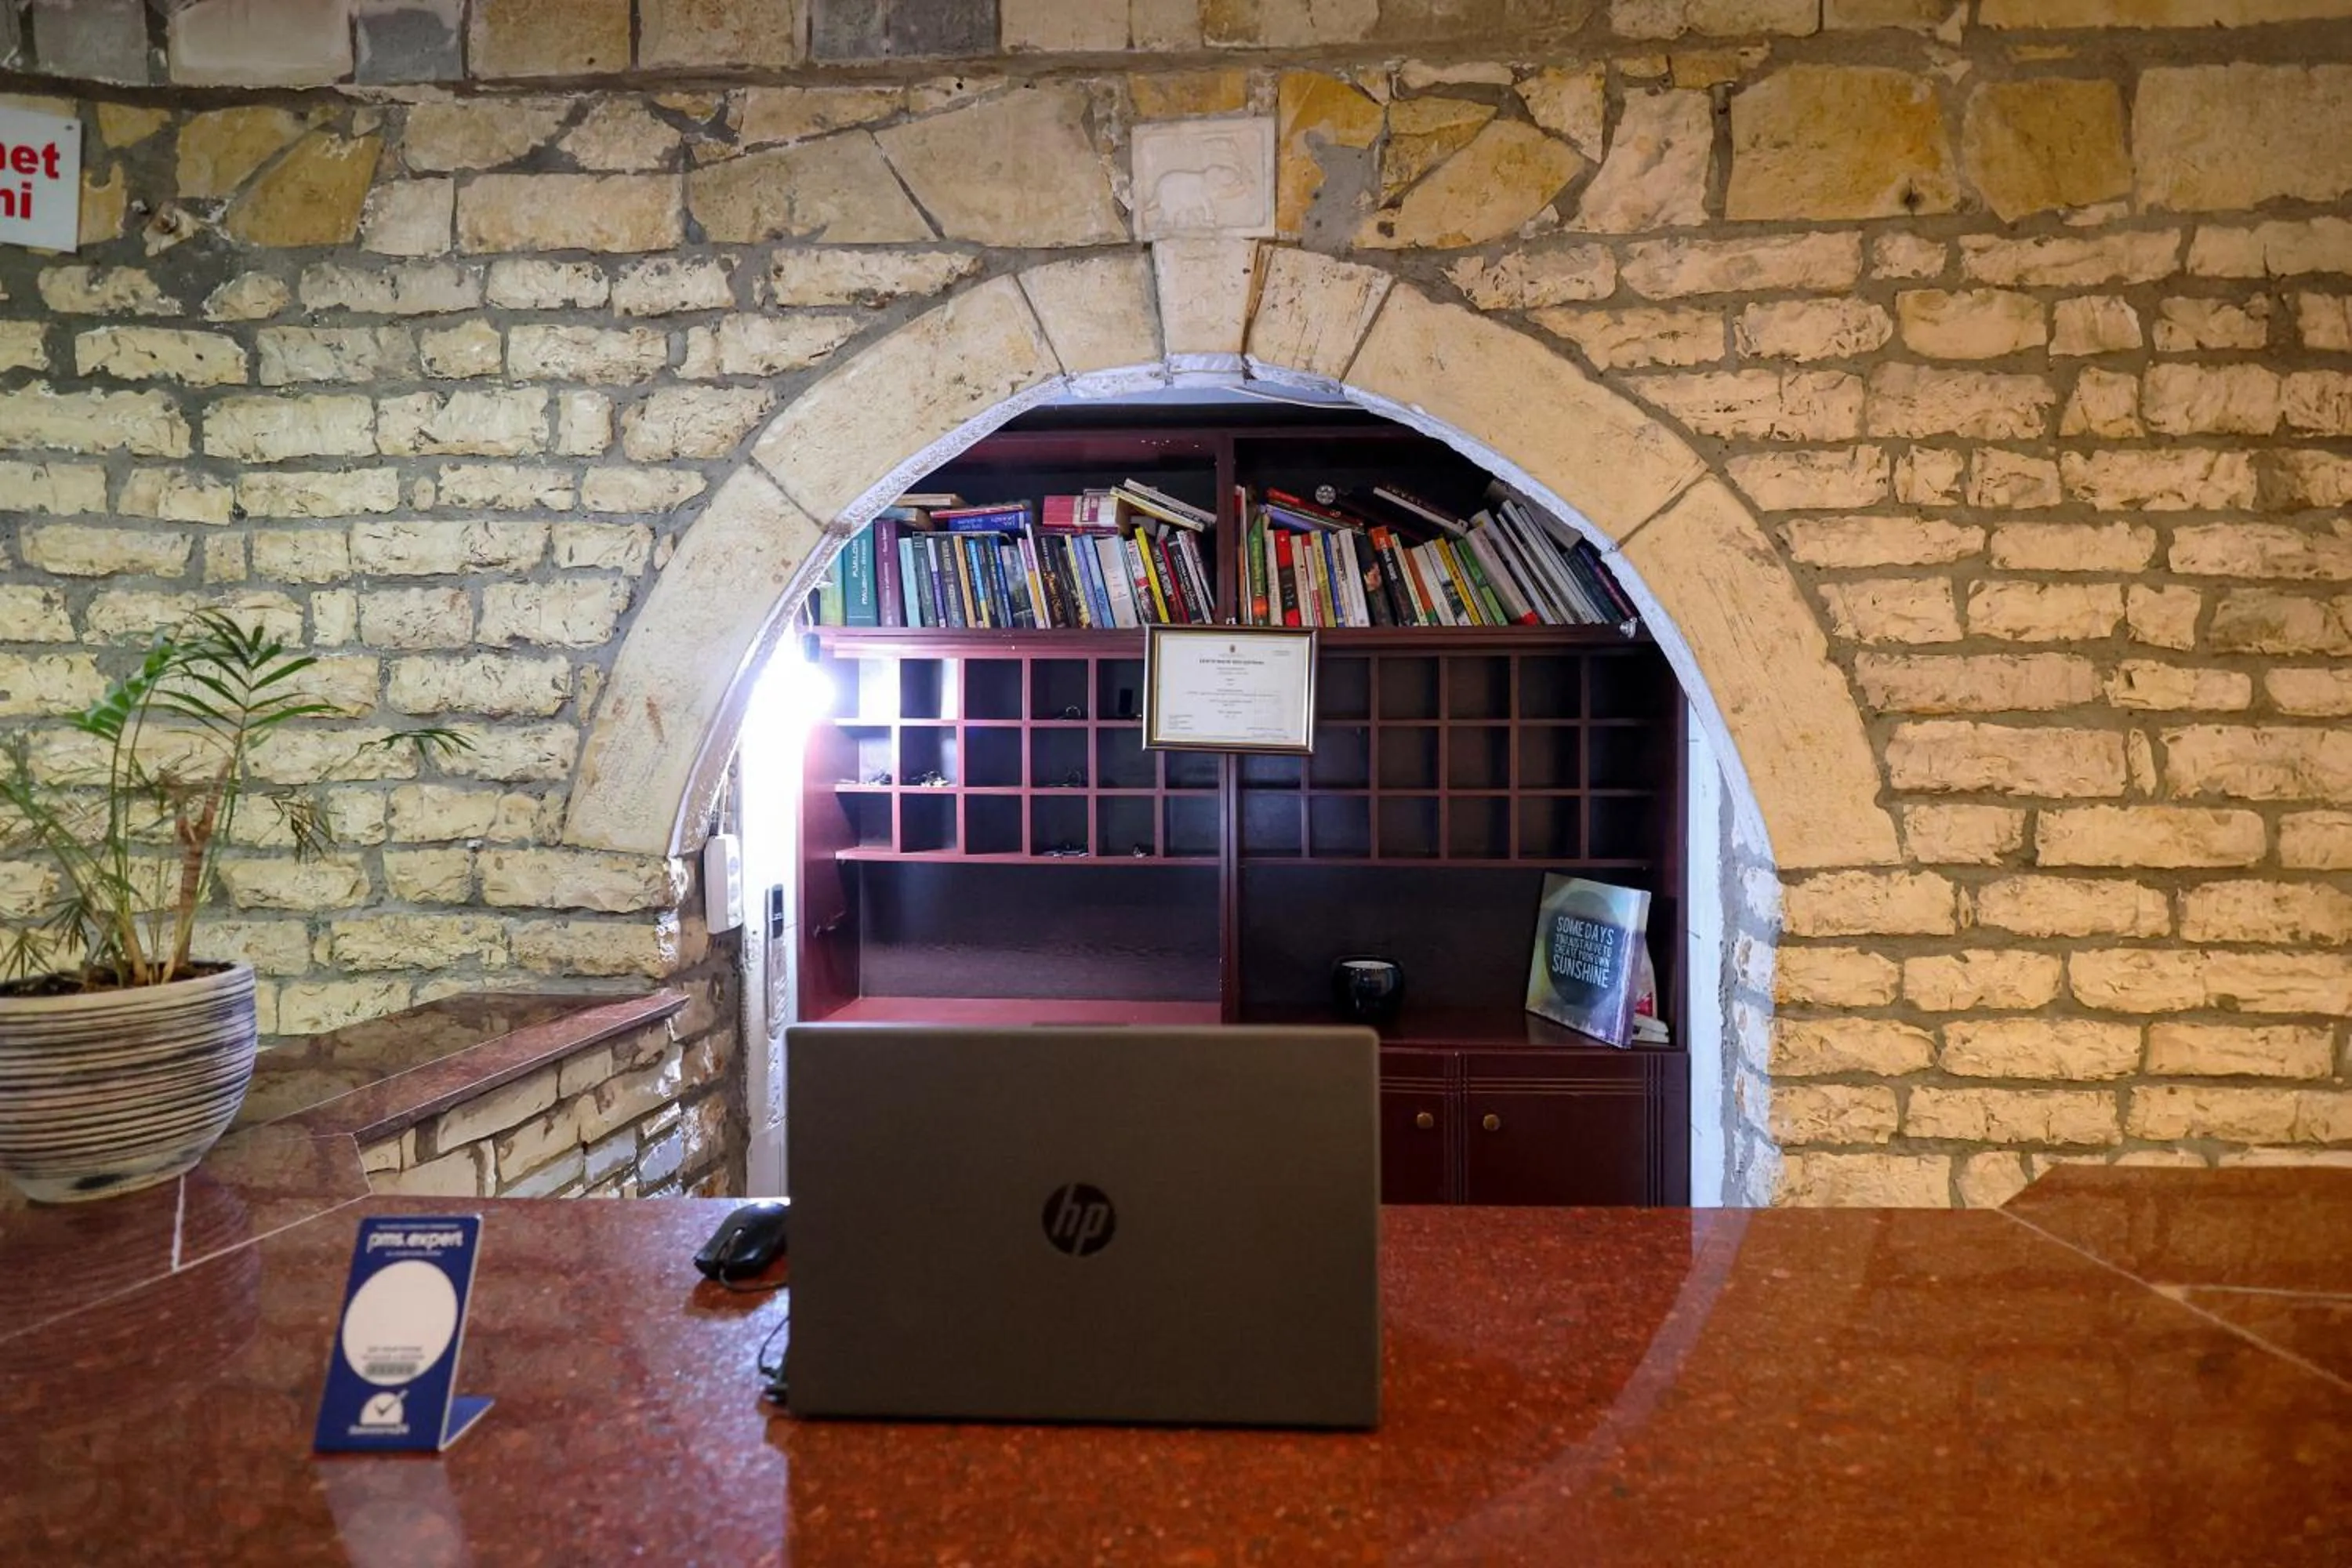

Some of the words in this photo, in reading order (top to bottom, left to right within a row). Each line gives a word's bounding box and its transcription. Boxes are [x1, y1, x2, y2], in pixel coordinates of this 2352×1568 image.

[0, 142, 60, 180] et
[1556, 916, 1584, 937] SOME
[1584, 923, 1614, 946] DAYS
[1552, 954, 1610, 988] SUNSHINE
[1051, 1181, 1109, 1256] hp
